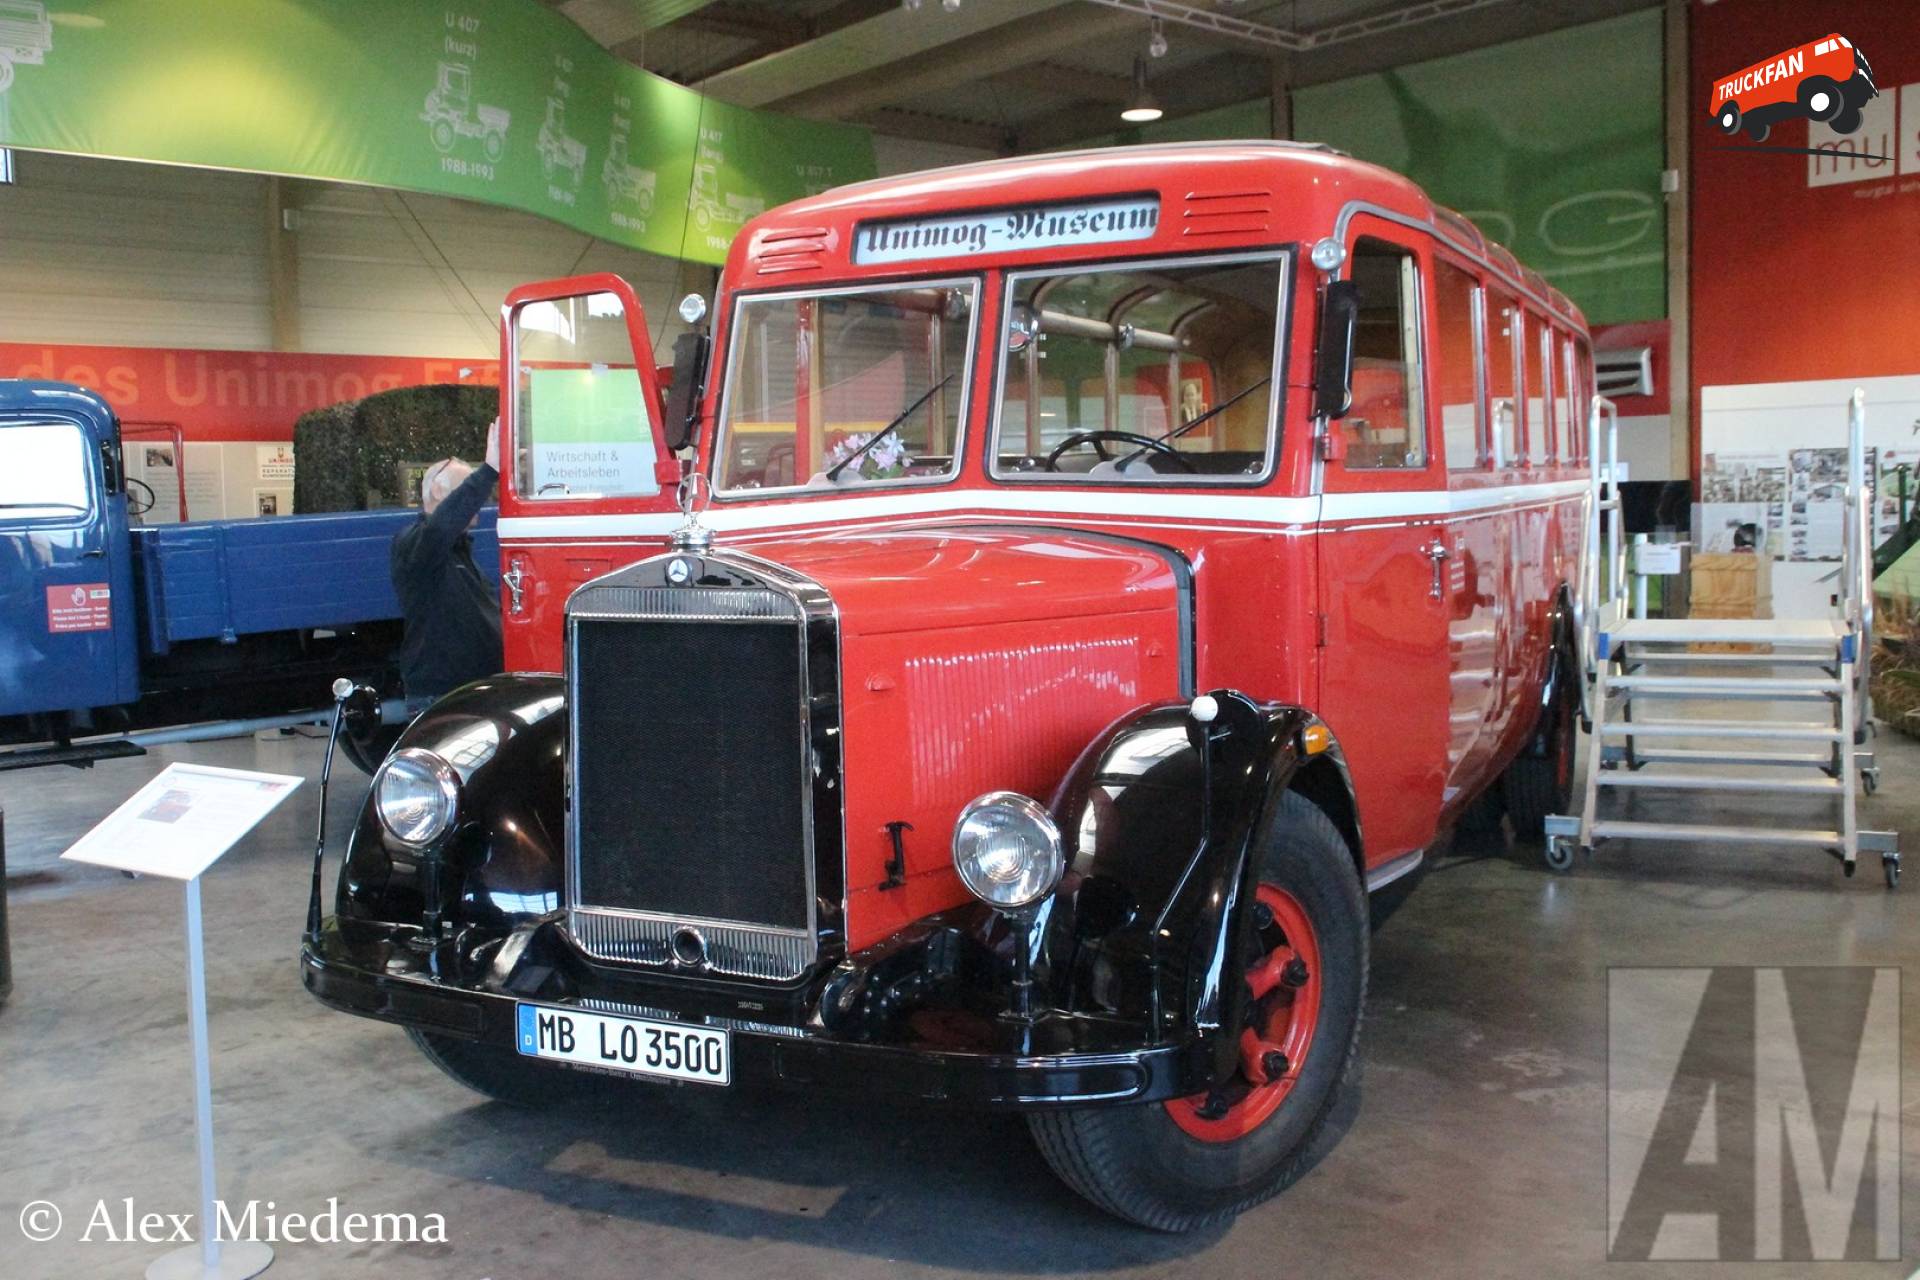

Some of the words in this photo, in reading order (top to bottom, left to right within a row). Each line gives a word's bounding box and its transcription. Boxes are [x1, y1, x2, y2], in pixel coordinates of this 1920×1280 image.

[445, 12, 455, 28] U
[458, 15, 480, 33] 407
[440, 157, 495, 182] 1988-1993
[866, 206, 1159, 252] Unimog-Museum
[546, 449, 606, 463] Wirtschaft
[610, 450, 619, 461] &
[546, 466, 620, 479] Arbeitsleben
[537, 1012, 576, 1053] MB
